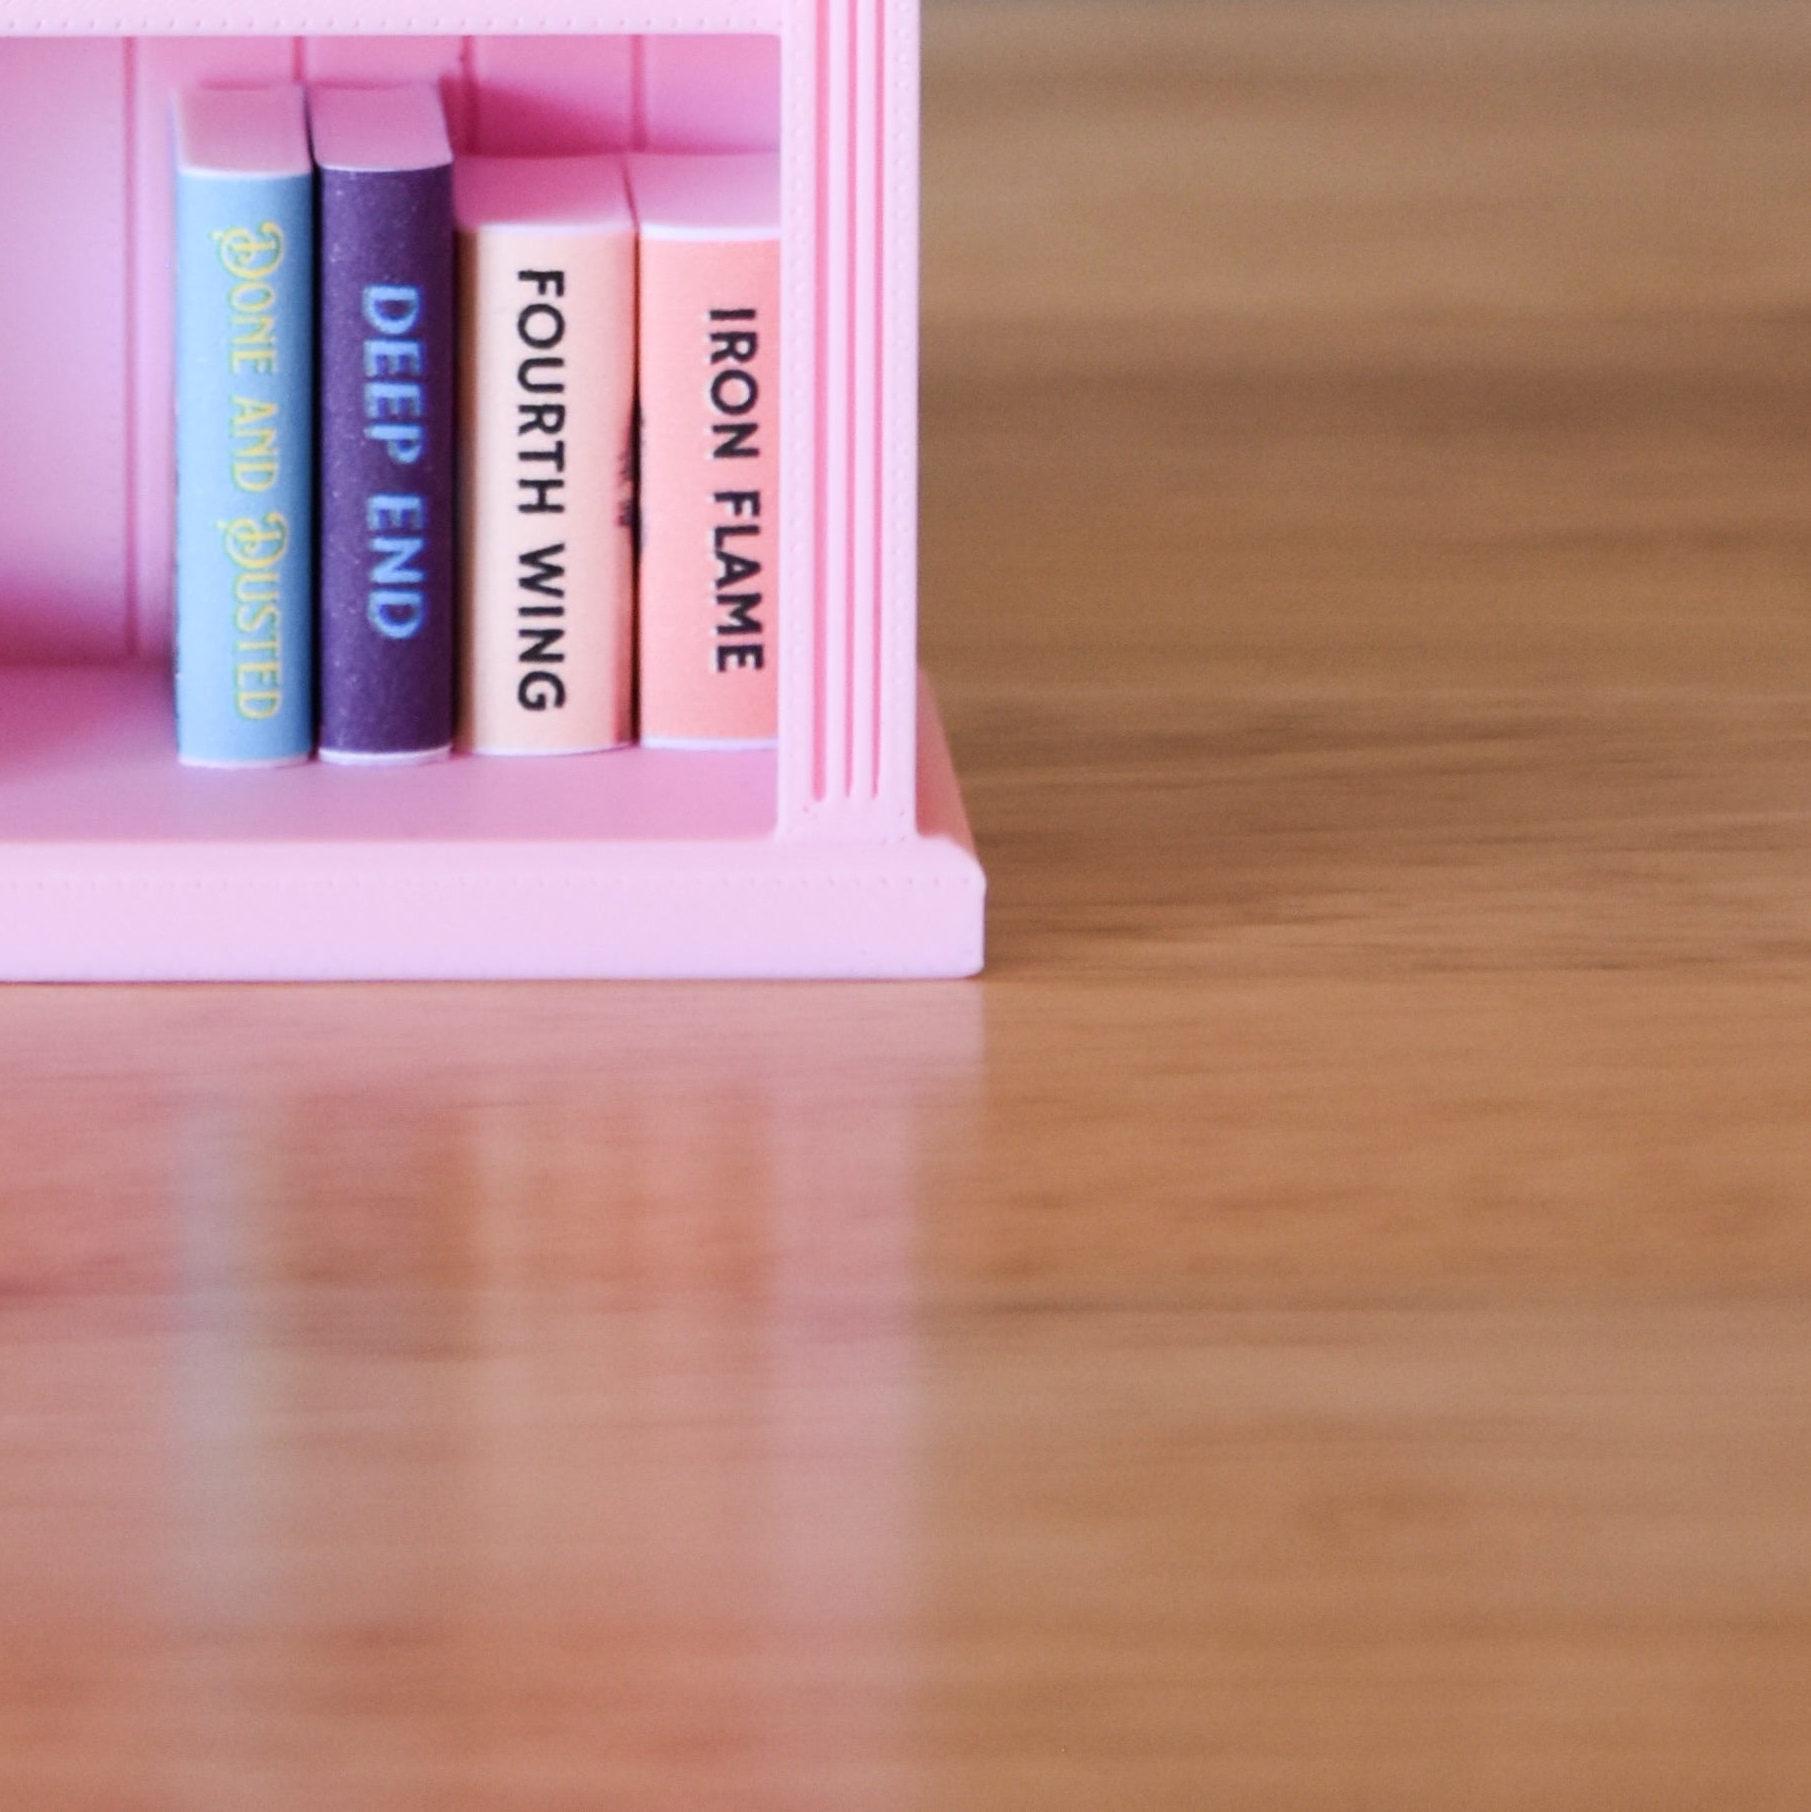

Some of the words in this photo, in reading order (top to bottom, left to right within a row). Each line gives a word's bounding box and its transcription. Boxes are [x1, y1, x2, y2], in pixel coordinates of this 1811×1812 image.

[230, 394, 277, 492] AND
[362, 283, 424, 466] DEEP
[517, 270, 565, 514] FOURTH
[708, 307, 758, 459] IRON
[366, 493, 426, 641] END
[517, 544, 565, 712] WING
[713, 490, 764, 673] FLAME
